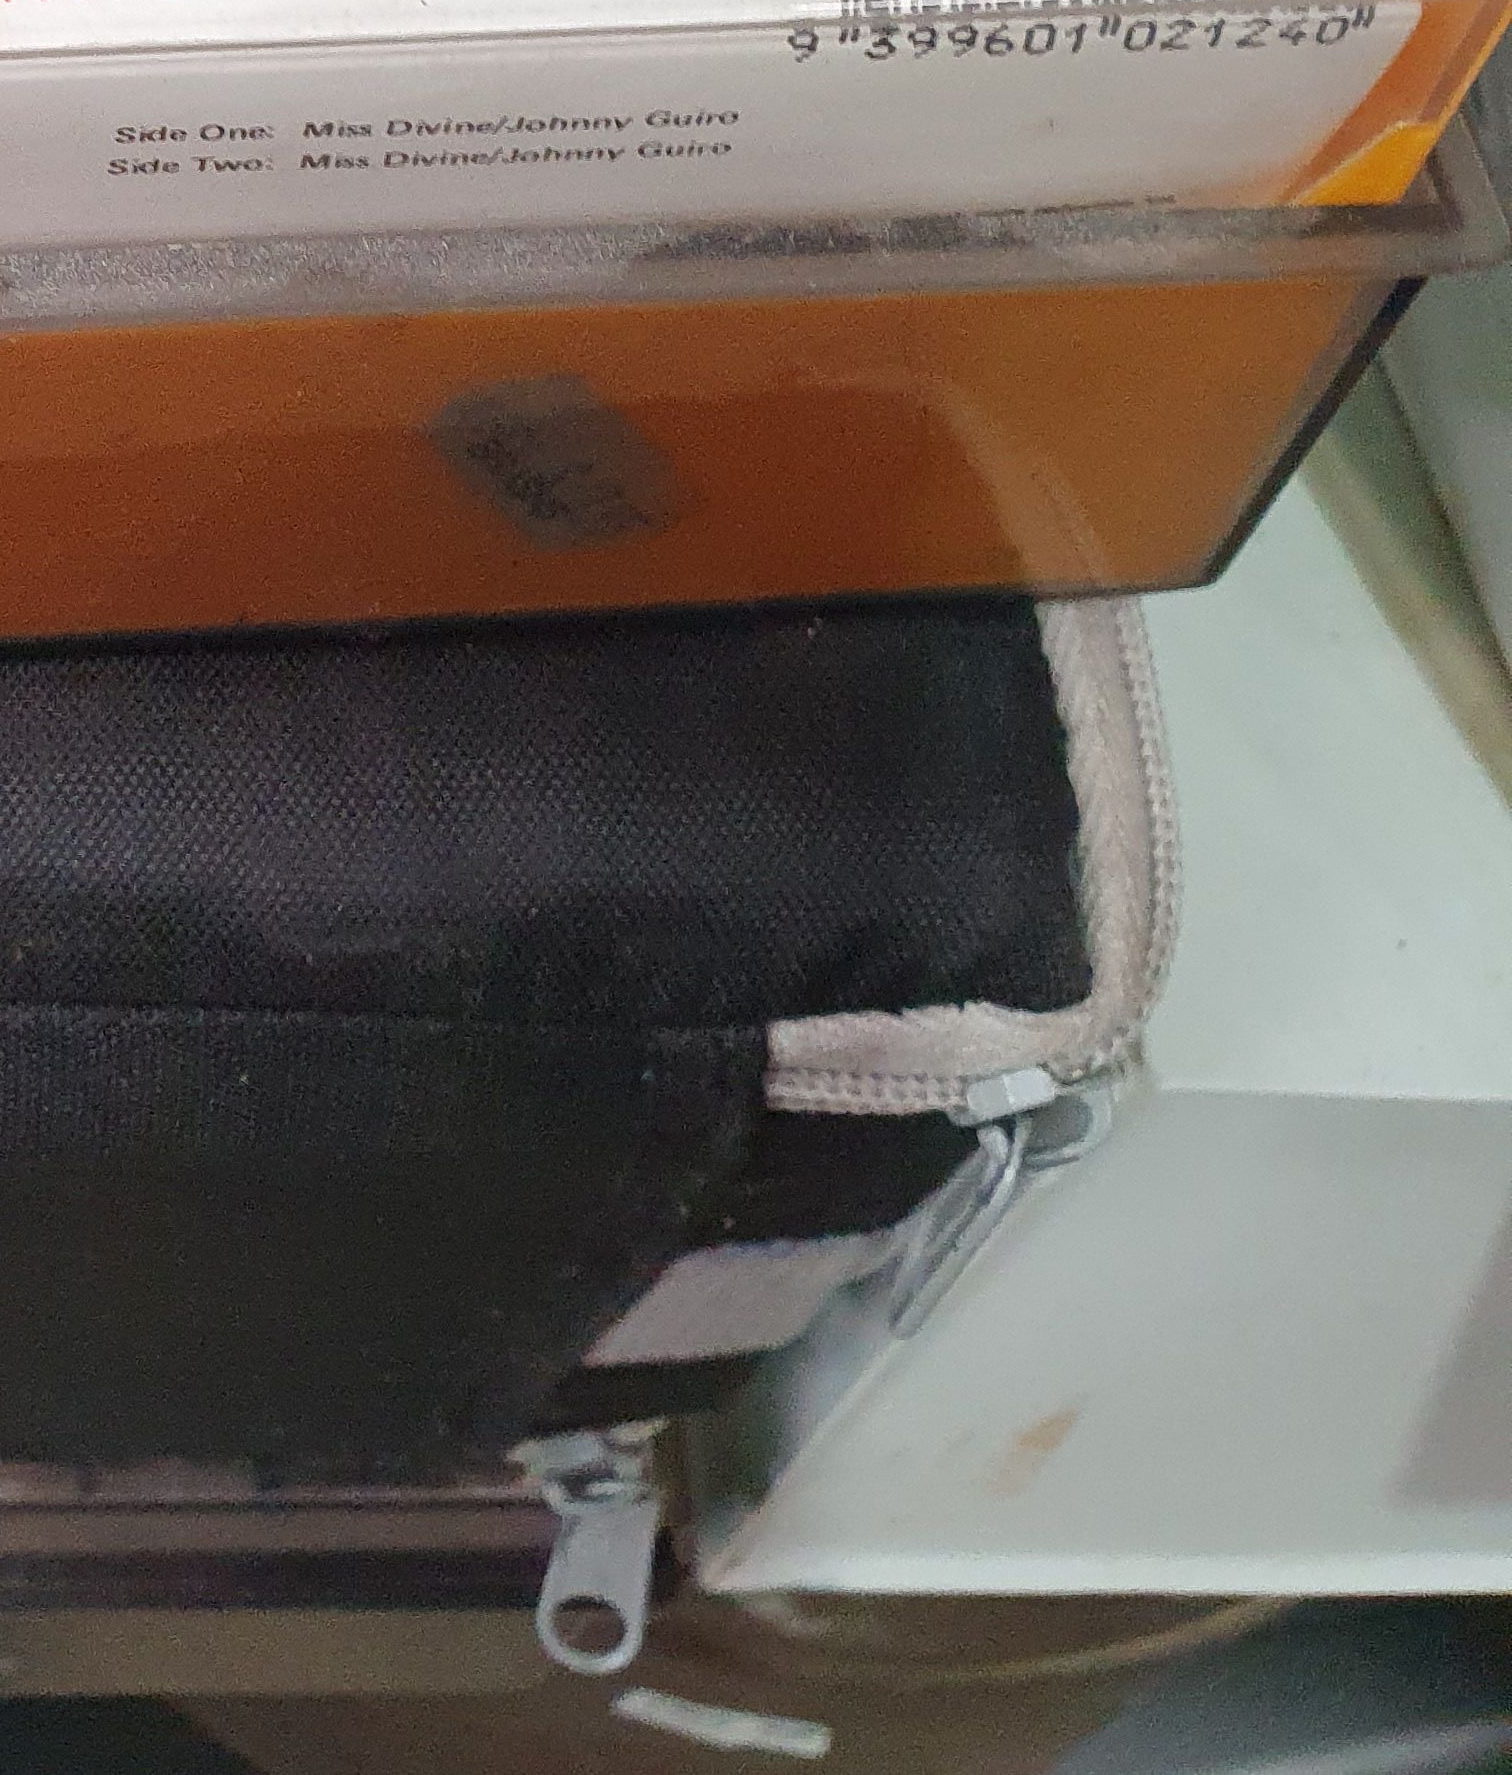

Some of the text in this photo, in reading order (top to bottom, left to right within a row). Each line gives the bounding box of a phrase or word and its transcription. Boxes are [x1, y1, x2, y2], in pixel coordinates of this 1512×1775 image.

[115, 107, 740, 145] Side One: Miss Divine/Johnny Guiro
[107, 156, 180, 176] Side
[195, 155, 274, 175] Two:
[299, 151, 371, 172] Miss
[384, 143, 627, 169] Divine/Johnny
